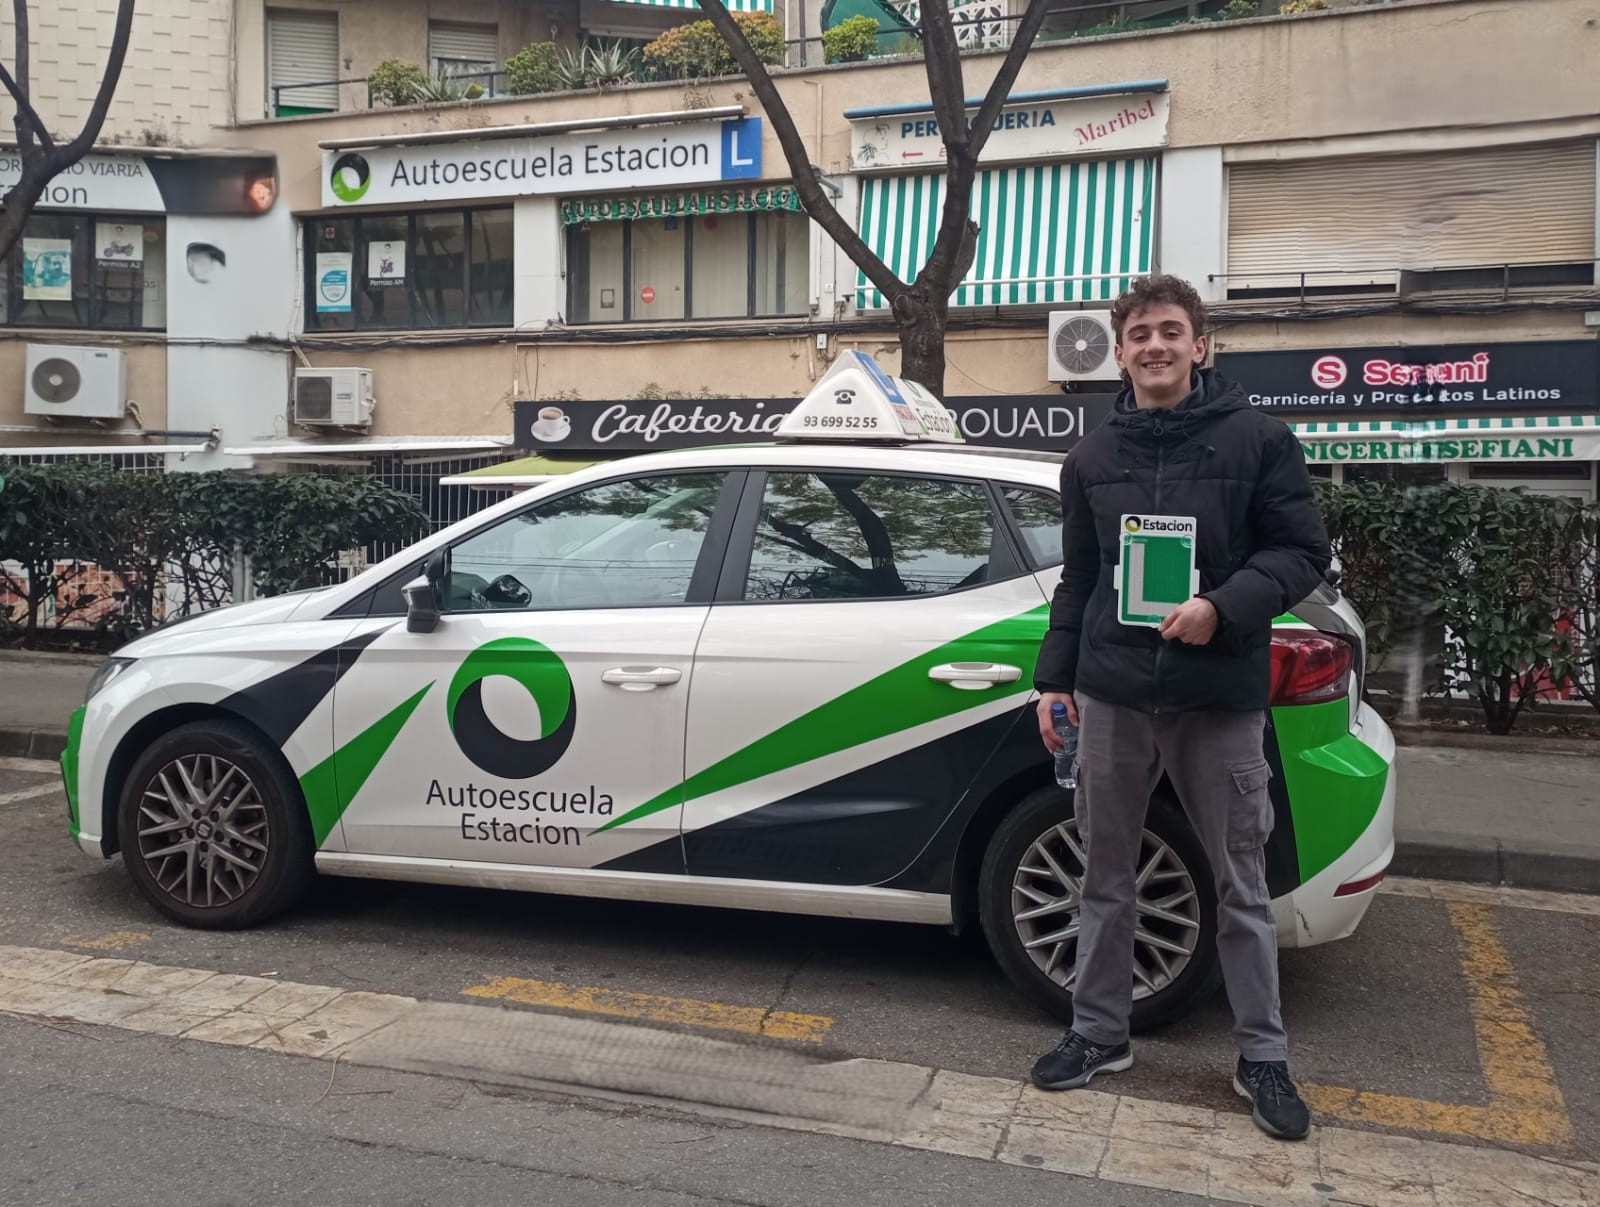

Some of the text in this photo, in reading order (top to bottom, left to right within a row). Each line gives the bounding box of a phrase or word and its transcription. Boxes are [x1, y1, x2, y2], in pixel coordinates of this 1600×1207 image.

[1074, 100, 1155, 146] Maribel
[390, 138, 709, 187] Autoescuela Estacion
[731, 130, 753, 166] L
[89, 162, 144, 177] VIARIA
[1248, 391, 1346, 406] Carnicería
[1353, 394, 1364, 406] y
[1482, 387, 1561, 402] Latinos
[803, 416, 877, 428] 93 699 52 55
[1142, 519, 1193, 532] Estacion
[1127, 541, 1184, 618] L
[426, 779, 613, 815] Autoescuela
[461, 813, 580, 846] Estacion
